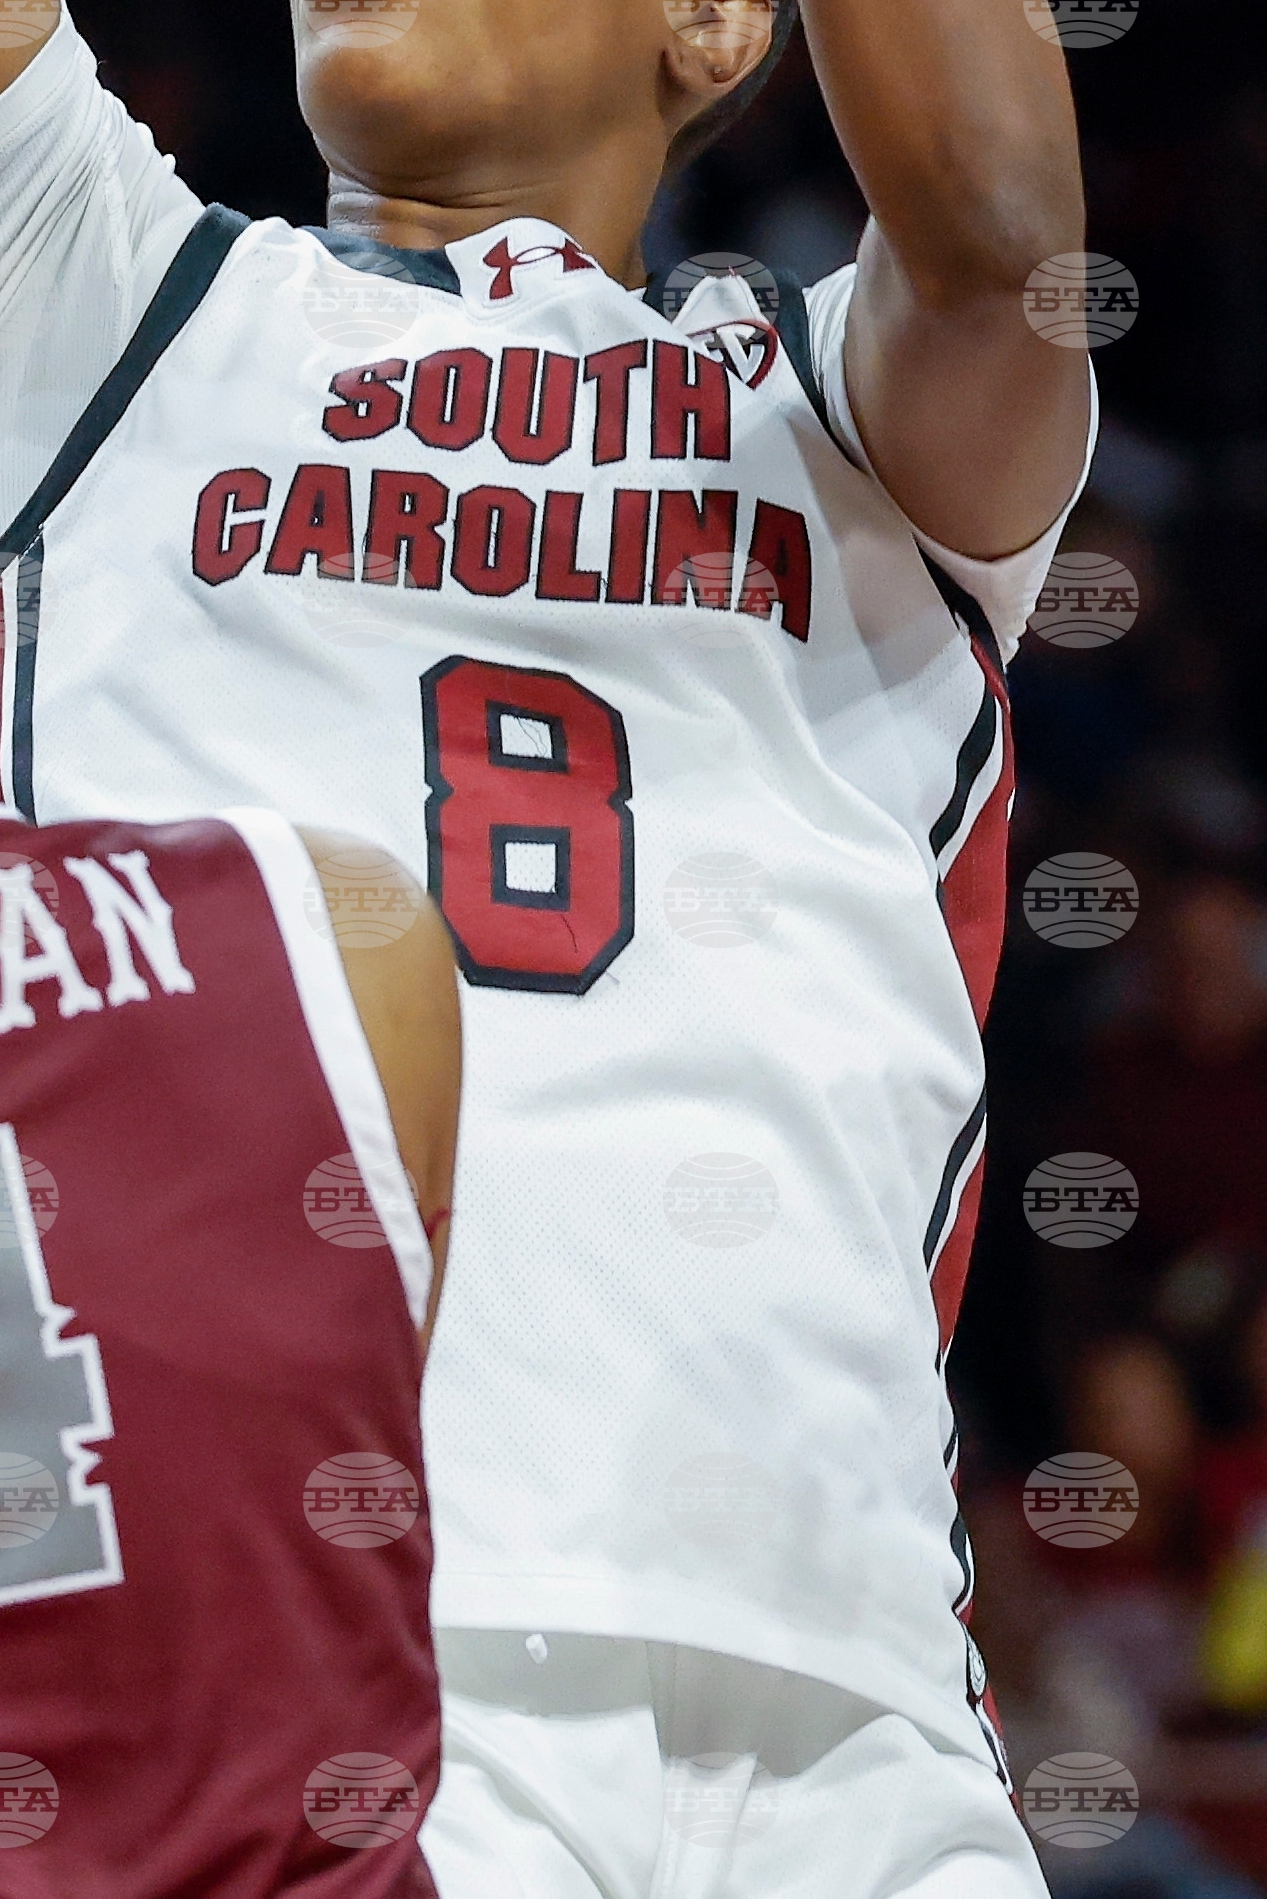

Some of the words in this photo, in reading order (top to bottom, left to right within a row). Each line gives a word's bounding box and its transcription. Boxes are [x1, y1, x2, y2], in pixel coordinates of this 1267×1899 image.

[321, 338, 731, 467] SOUTH
[191, 464, 812, 643] CAROLINA
[420, 654, 635, 995] 8
